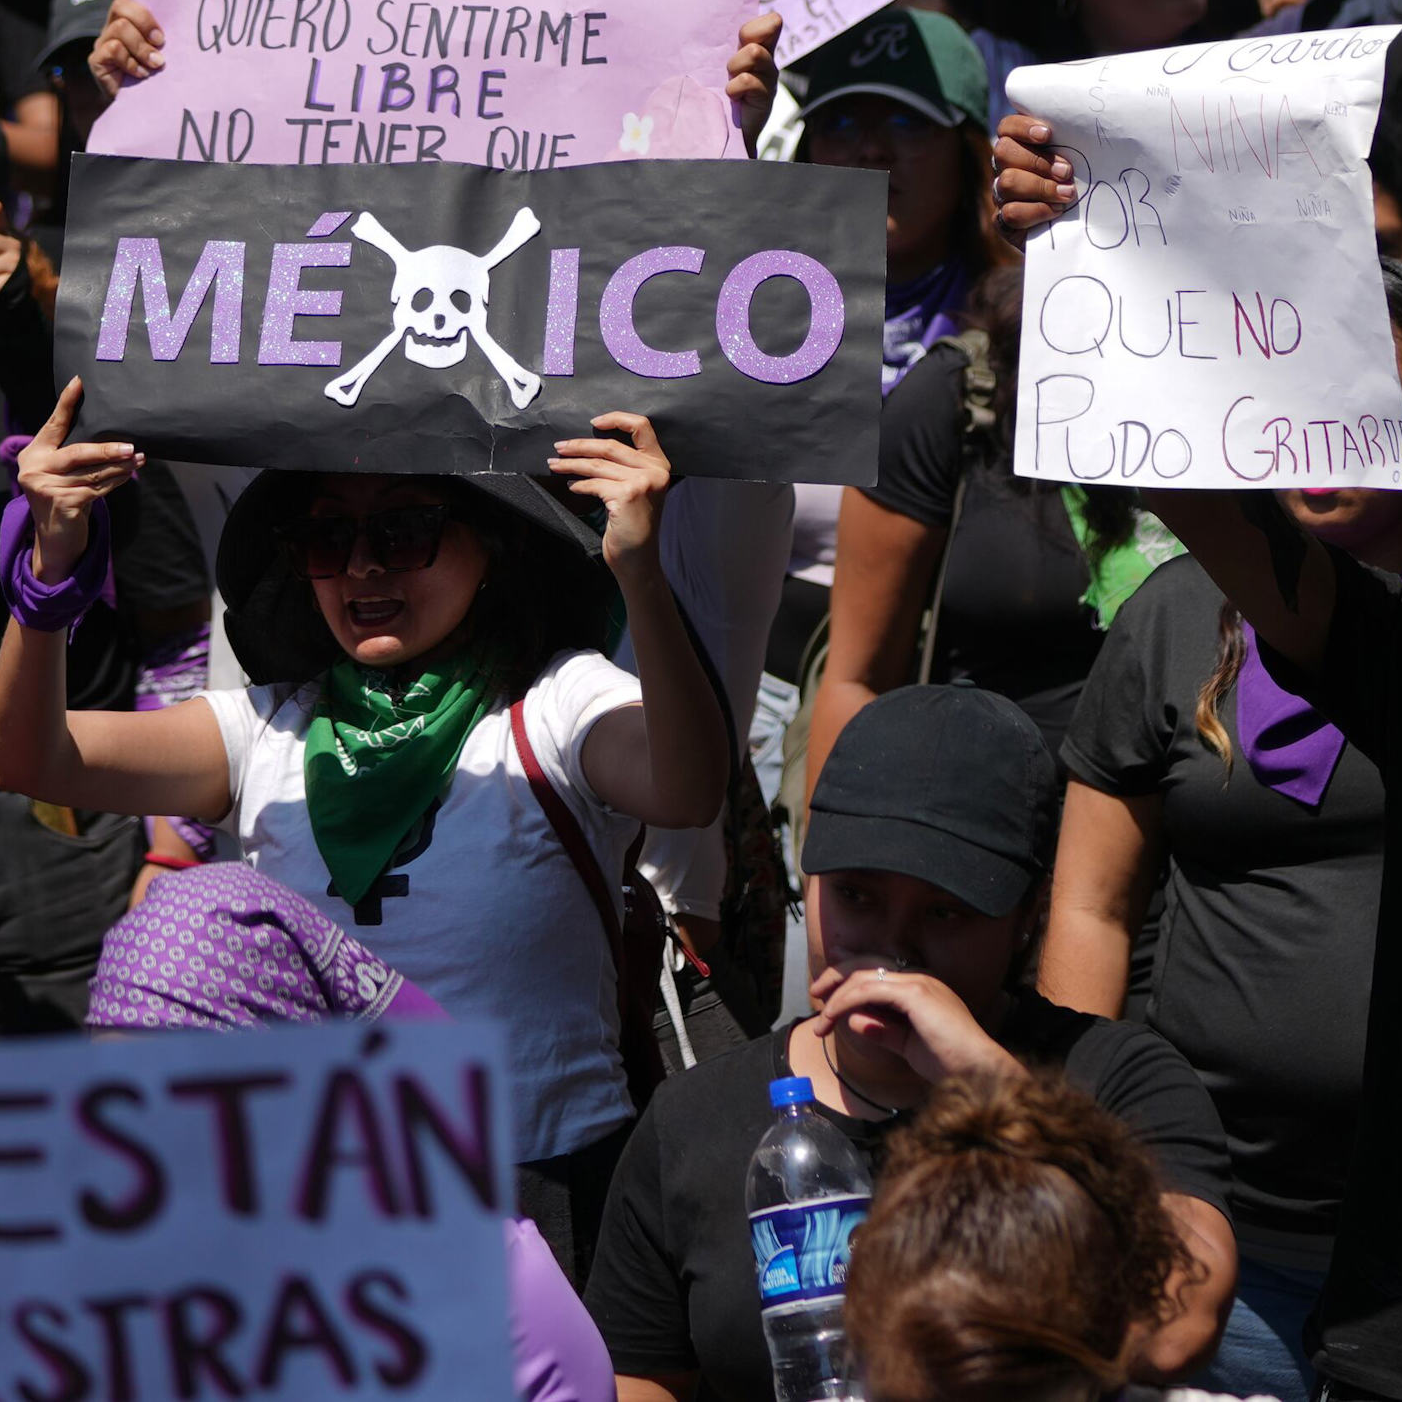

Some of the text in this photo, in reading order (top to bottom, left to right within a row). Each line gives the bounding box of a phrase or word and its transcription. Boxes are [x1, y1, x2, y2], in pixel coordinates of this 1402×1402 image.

[303, 57, 508, 120] LIBRE
[176, 106, 578, 170] NO TENER QUE
[1039, 274, 1302, 362] QUE NO
[1034, 372, 1194, 481] PUDO
